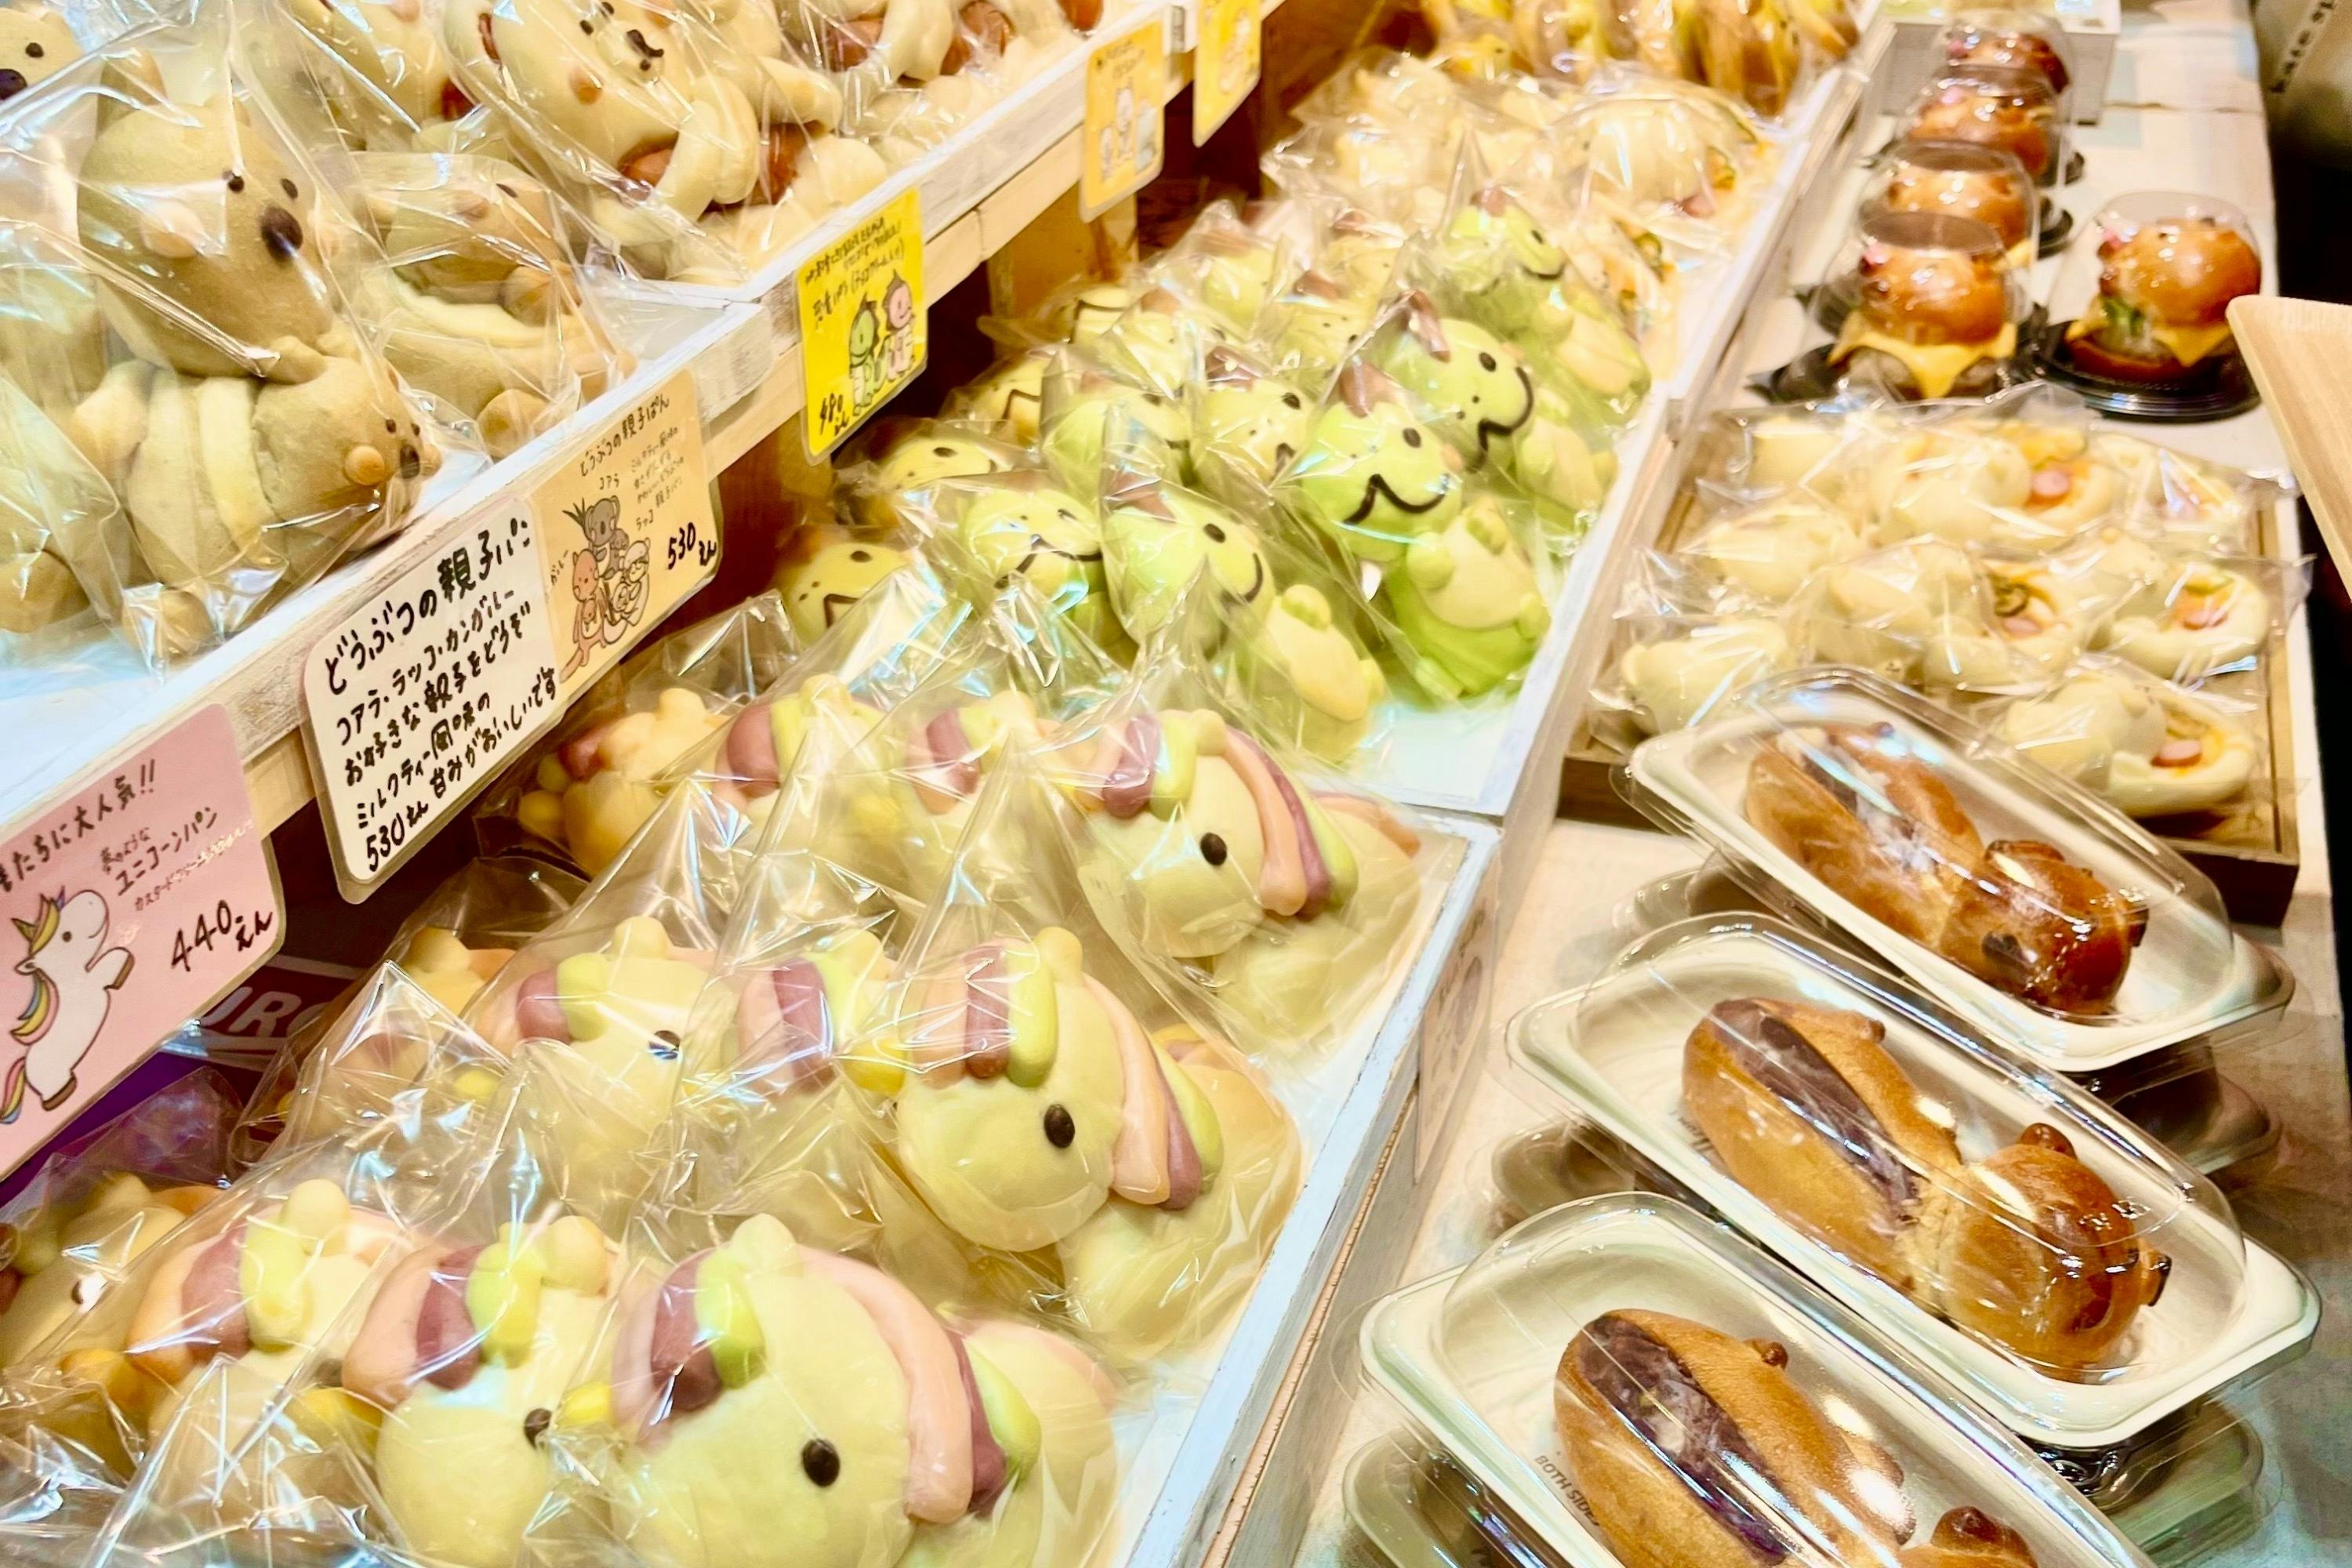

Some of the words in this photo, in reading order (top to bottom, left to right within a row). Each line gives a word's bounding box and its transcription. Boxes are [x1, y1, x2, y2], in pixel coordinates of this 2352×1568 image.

[325, 517, 530, 695] どうぶつの親子パン
[345, 601, 530, 786] お好きな親子をどうぞ
[358, 692, 490, 829] ミルクティー風味の
[430, 666, 556, 799] 甘みがおいしいです
[116, 807, 217, 896] ユニコーンパン
[1535, 1454, 1572, 1490] BOTH
